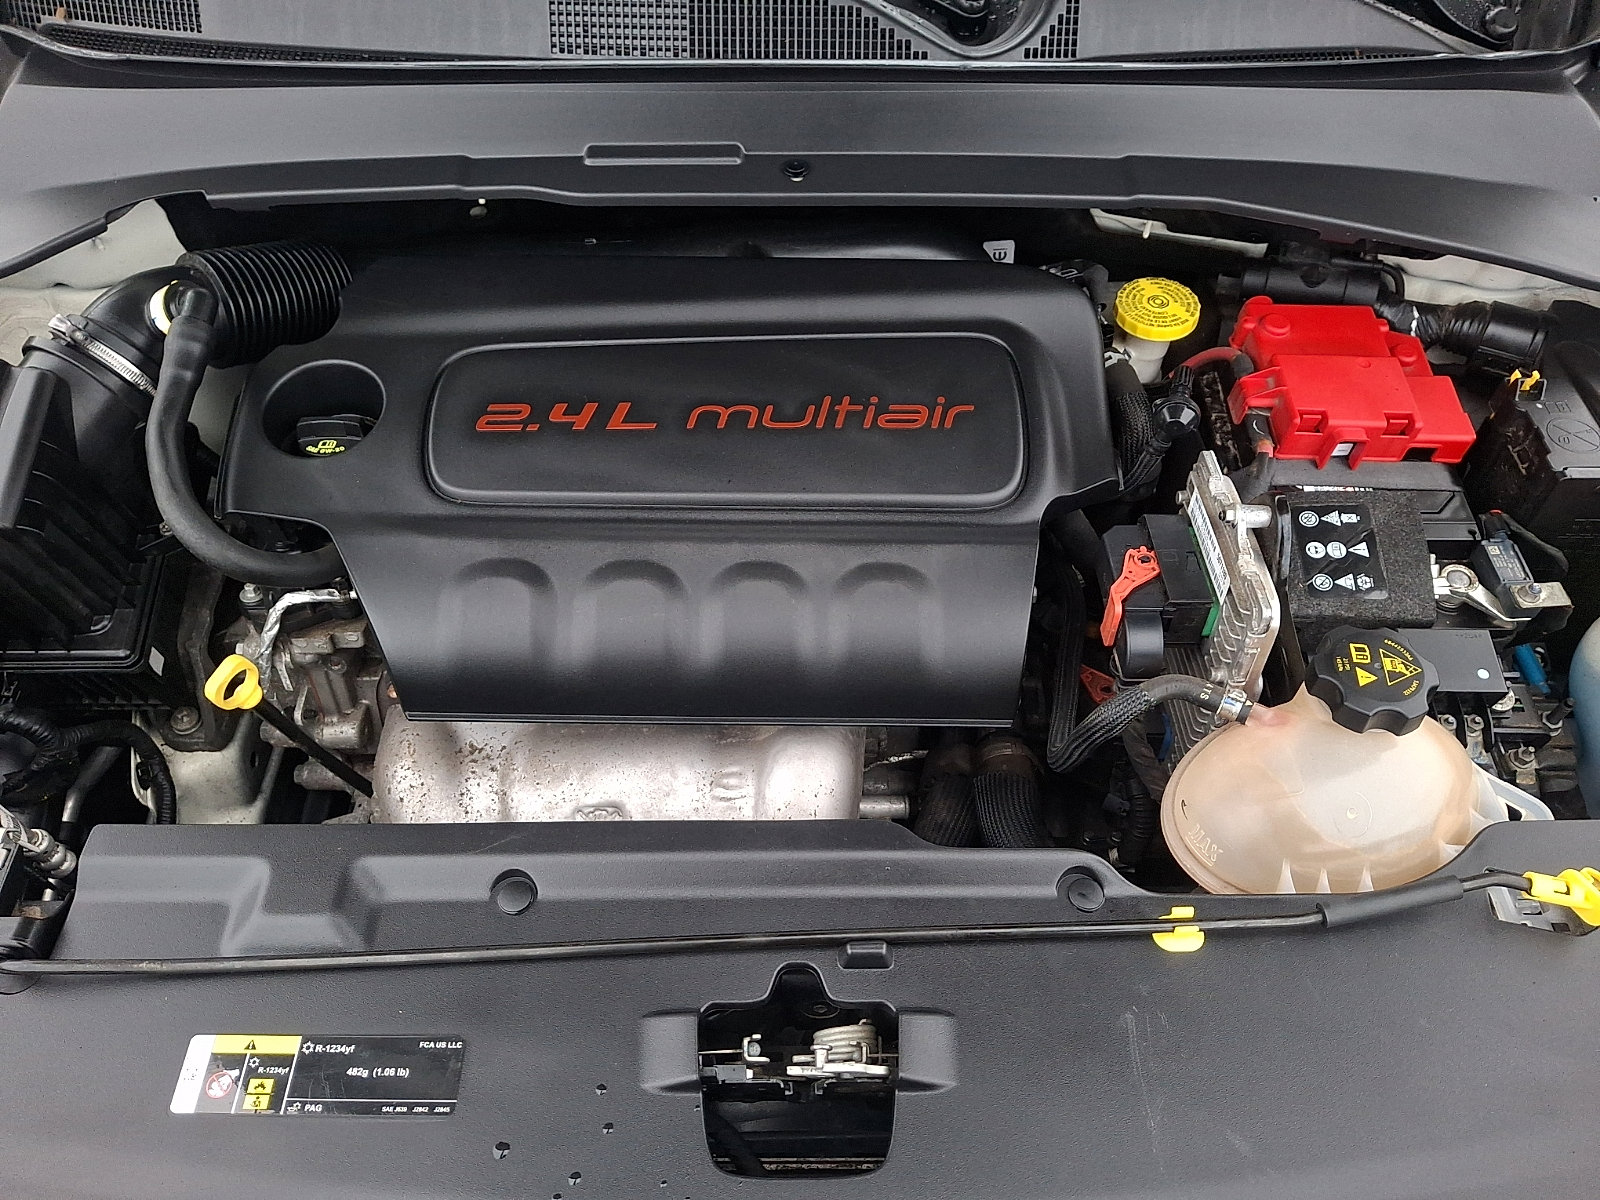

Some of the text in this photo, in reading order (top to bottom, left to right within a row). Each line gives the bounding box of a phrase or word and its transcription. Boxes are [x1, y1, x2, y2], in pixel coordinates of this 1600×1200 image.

[686, 395, 975, 430] multiair
[315, 1044, 356, 1054] R-1234yf
[419, 1041, 463, 1049] FCA US LLC
[257, 1066, 290, 1076] R-1234yf
[346, 1067, 410, 1078] 482g (1.06 lb)
[304, 1104, 323, 1112] PAG
